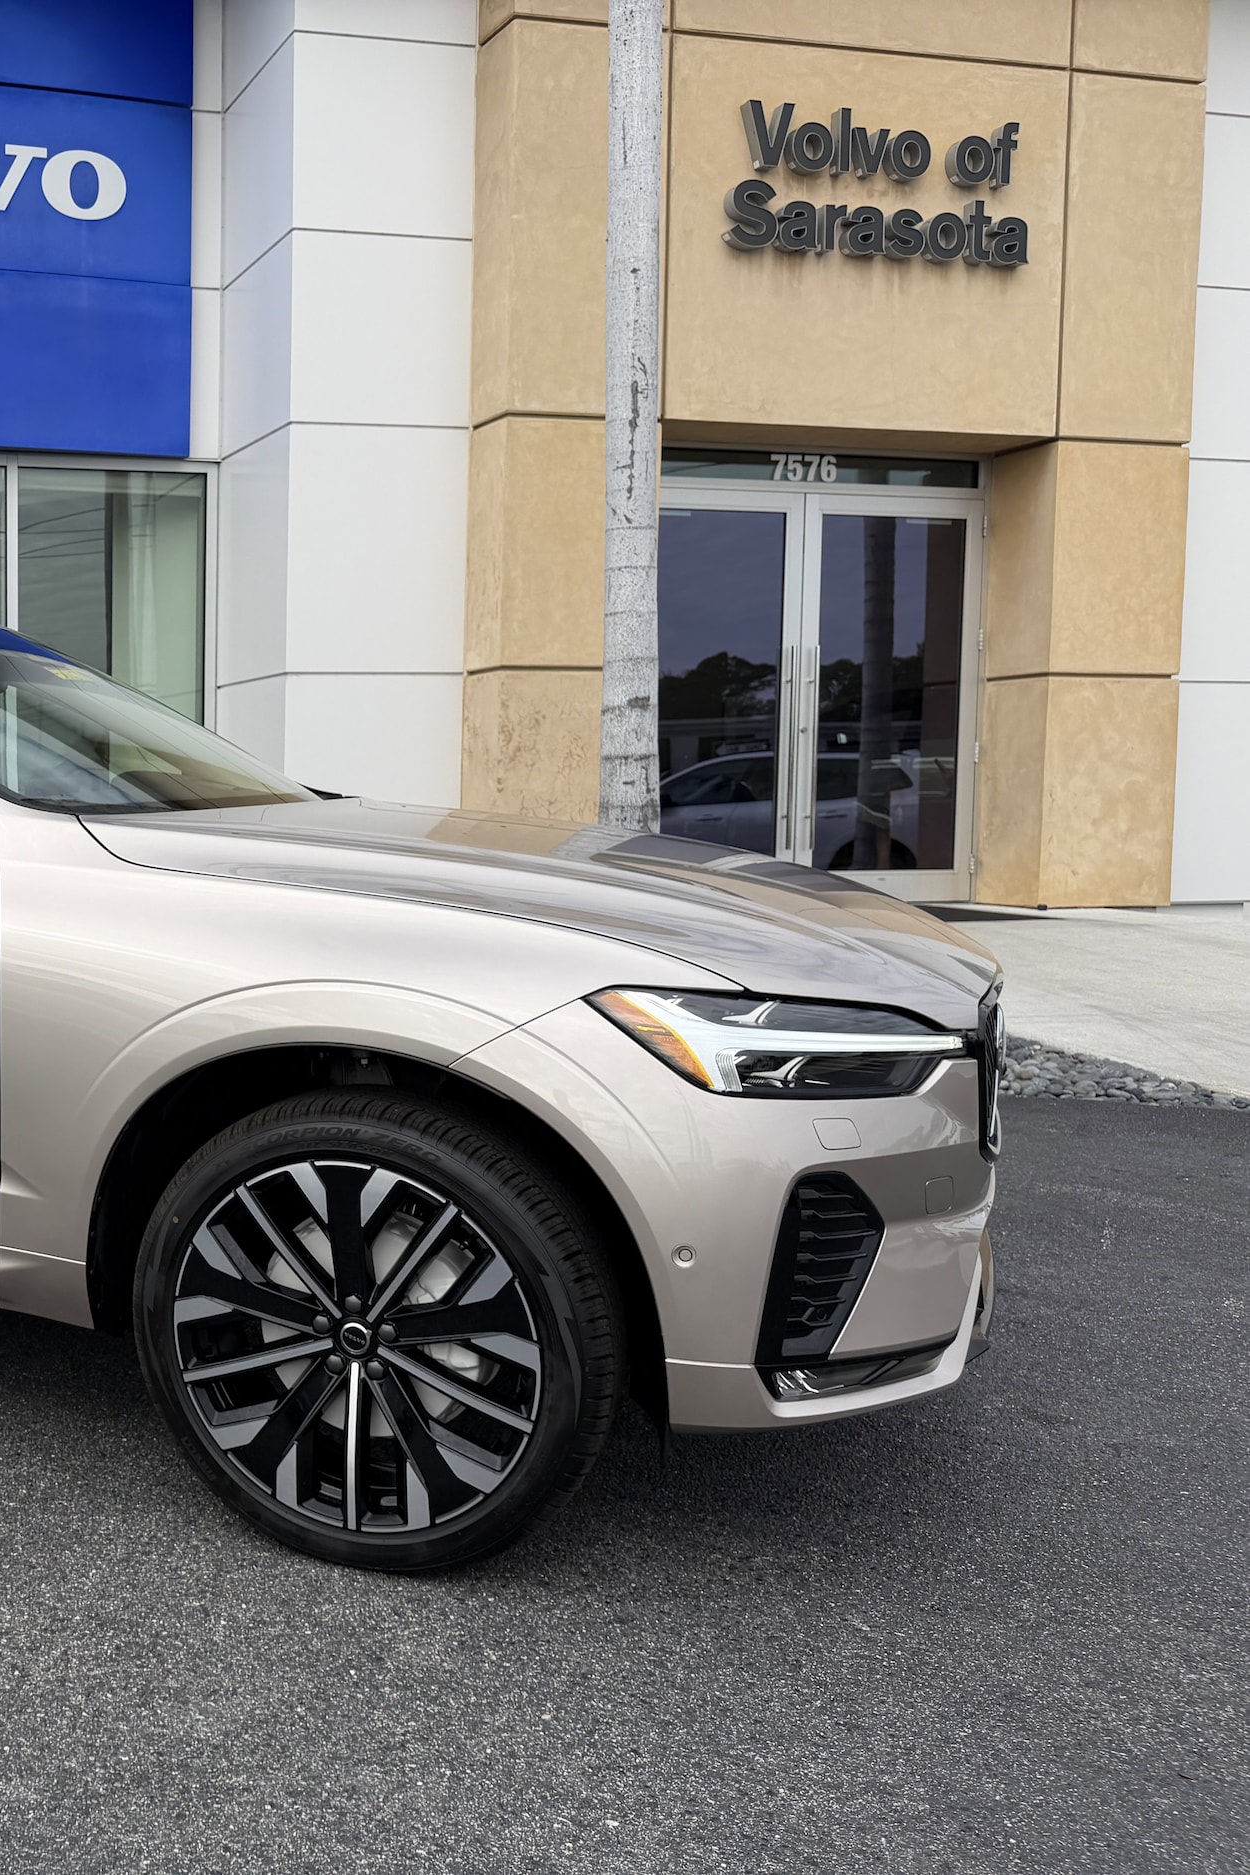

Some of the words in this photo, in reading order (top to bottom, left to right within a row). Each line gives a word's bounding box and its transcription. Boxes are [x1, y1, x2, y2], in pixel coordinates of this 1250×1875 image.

[740, 99, 932, 183] Volvo
[945, 121, 1021, 189] of
[721, 179, 1029, 268] Sarasota
[770, 454, 838, 482] 7576
[368, 1132, 442, 1163] ZERO
